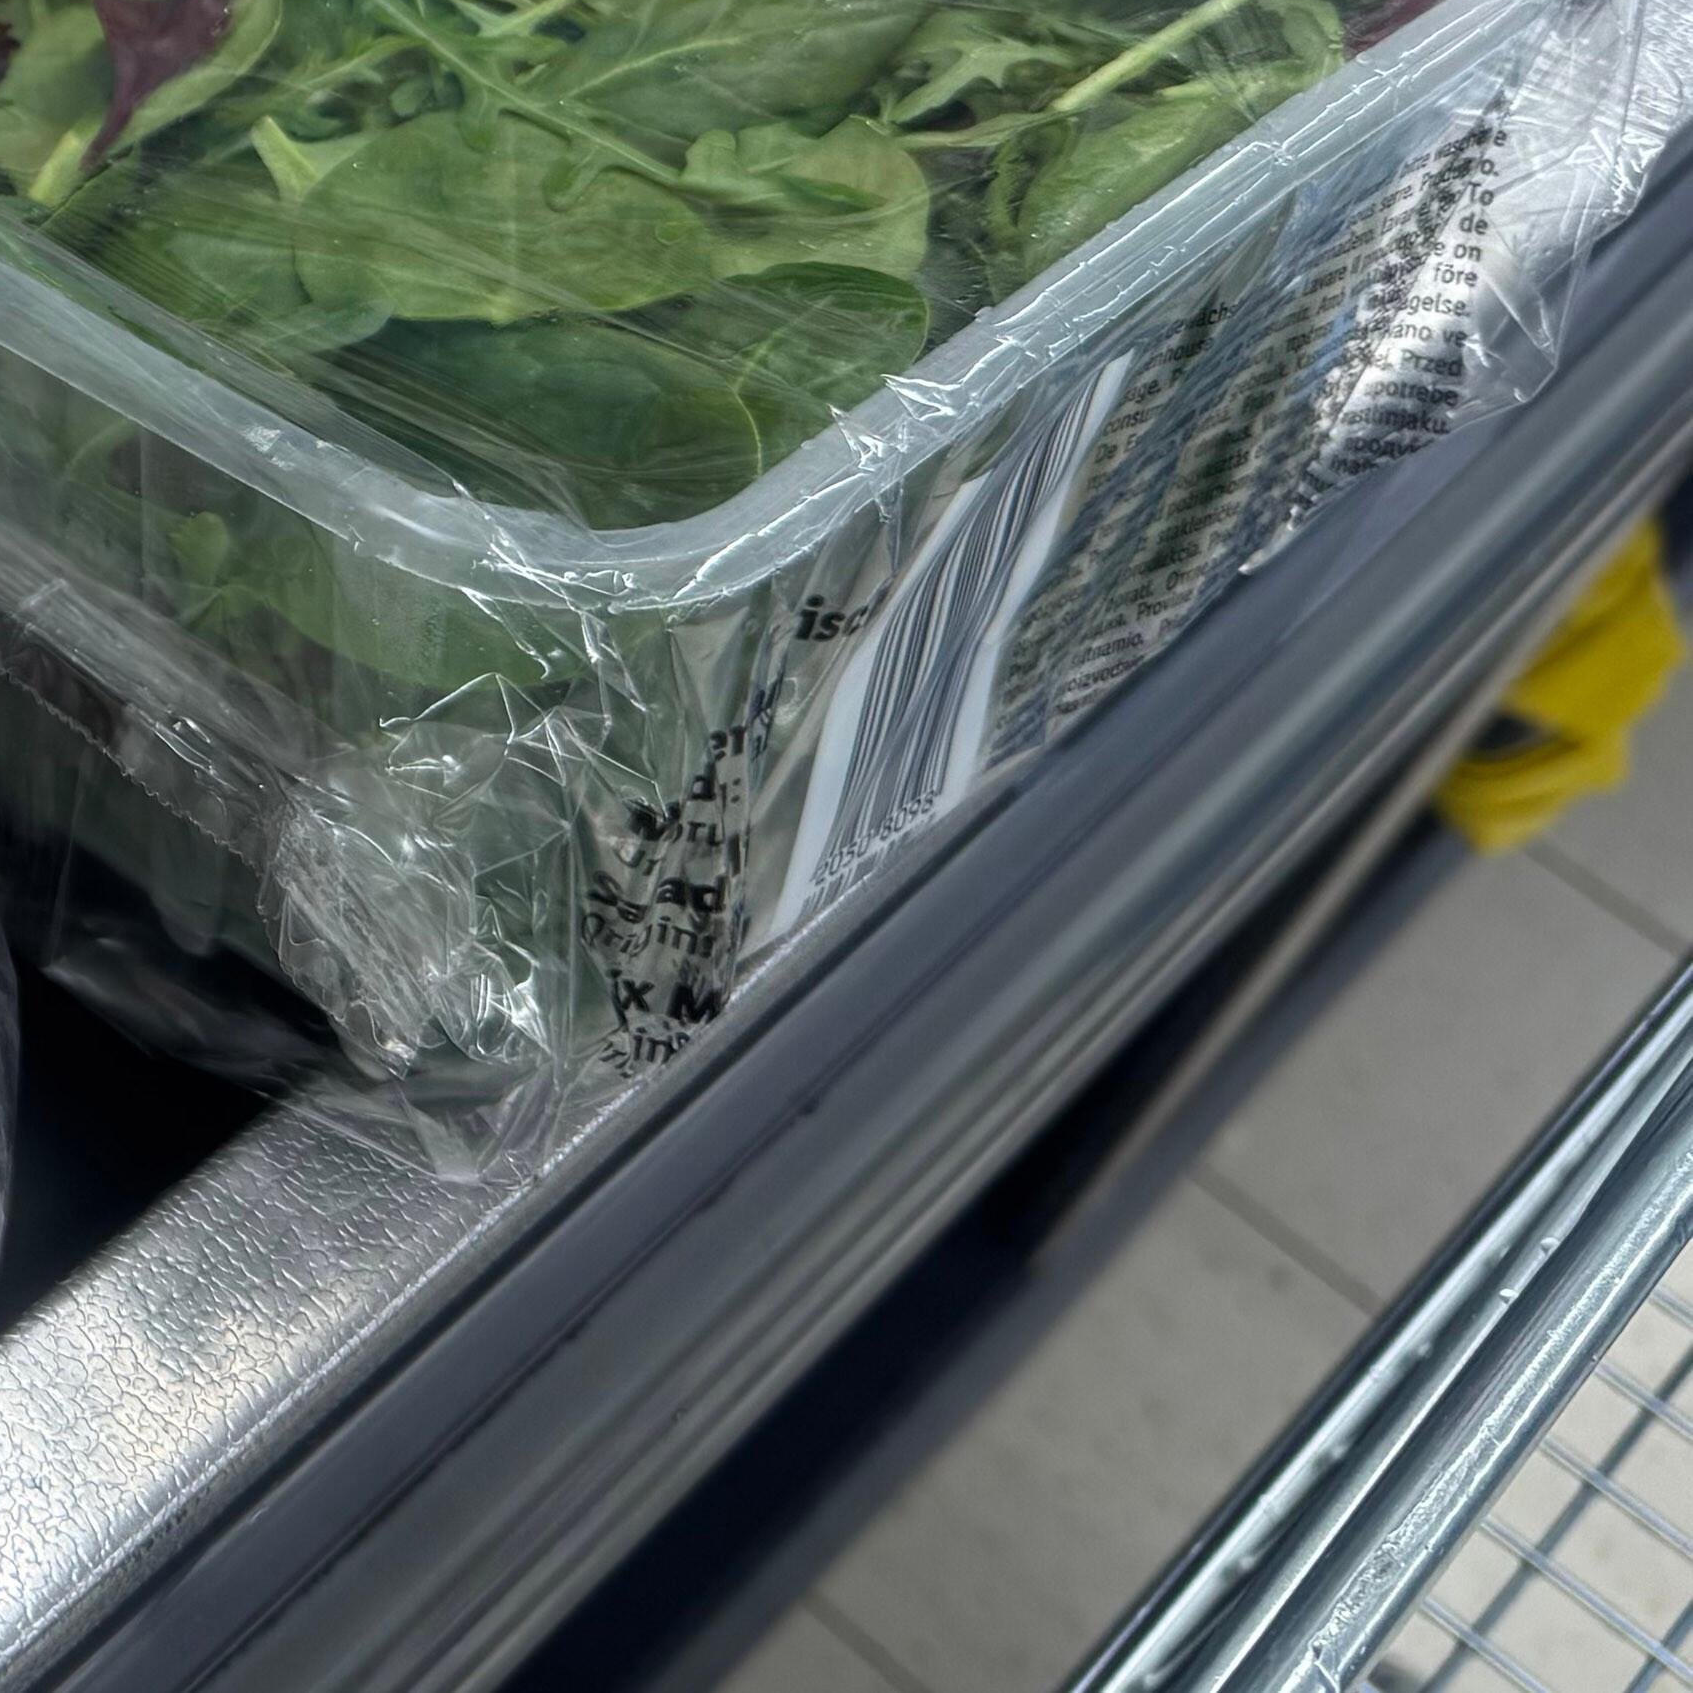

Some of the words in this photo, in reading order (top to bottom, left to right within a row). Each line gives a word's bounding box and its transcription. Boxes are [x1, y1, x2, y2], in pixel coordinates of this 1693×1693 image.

[1467, 184, 1495, 207] To
[1460, 213, 1488, 235] de
[1454, 244, 1482, 263] on
[1402, 349, 1463, 375] Przed
